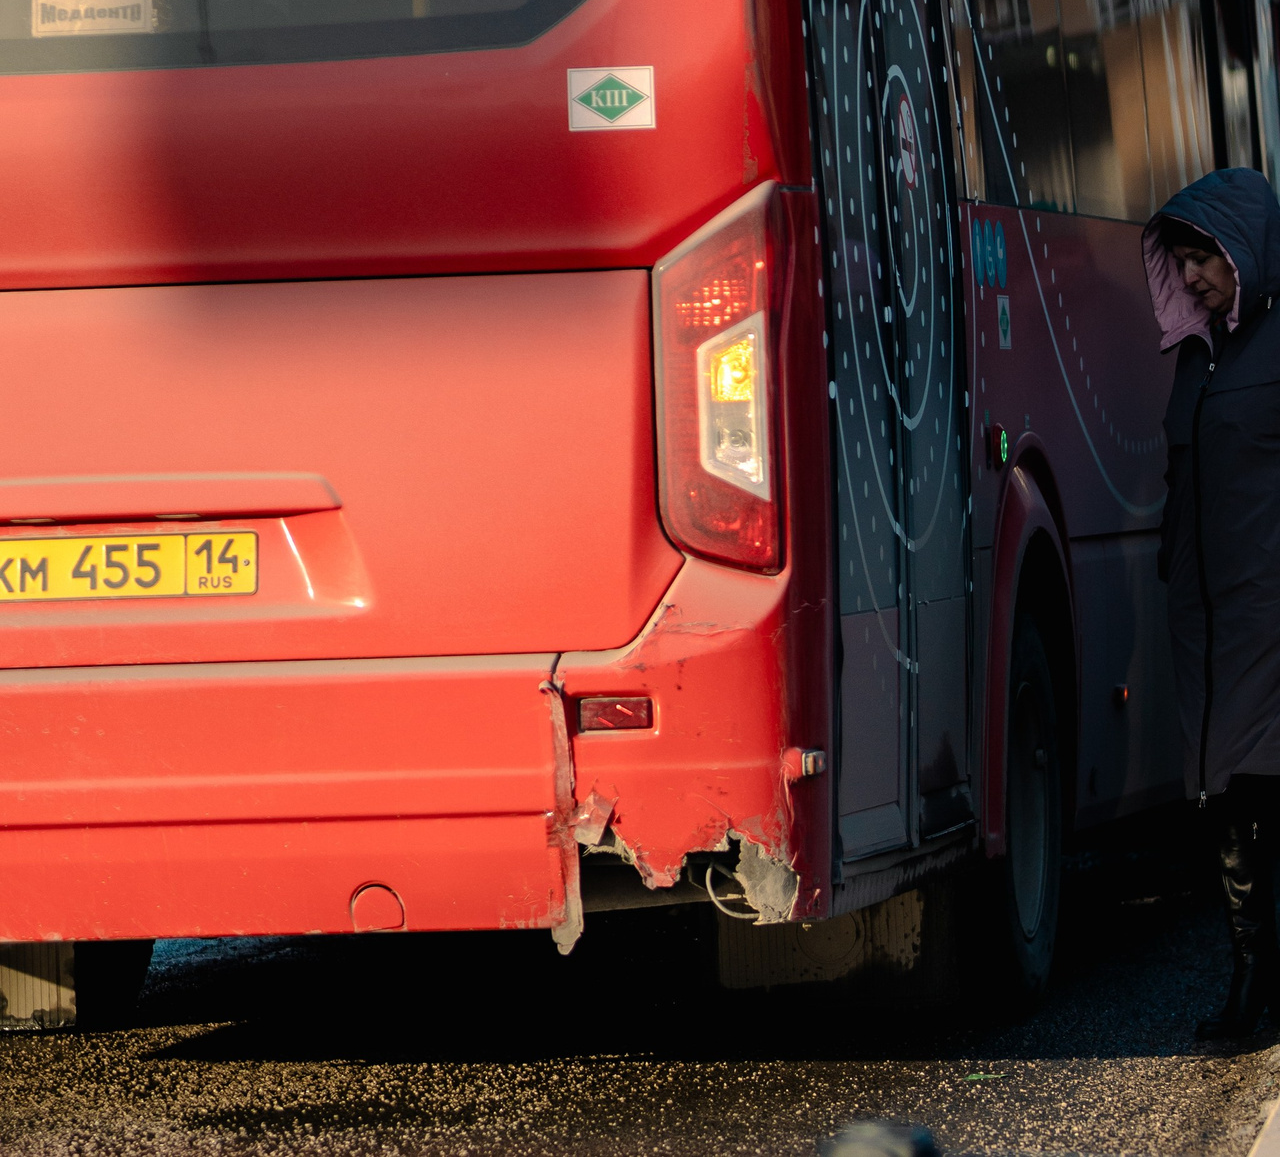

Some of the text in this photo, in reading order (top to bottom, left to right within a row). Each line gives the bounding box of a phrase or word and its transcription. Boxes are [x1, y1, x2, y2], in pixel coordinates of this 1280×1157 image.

[41, 3, 142, 24] Медцентр
[590, 89, 633, 107] КПГ
[71, 543, 162, 591] 455
[194, 538, 239, 575] 14
[198, 575, 233, 589] RUS
